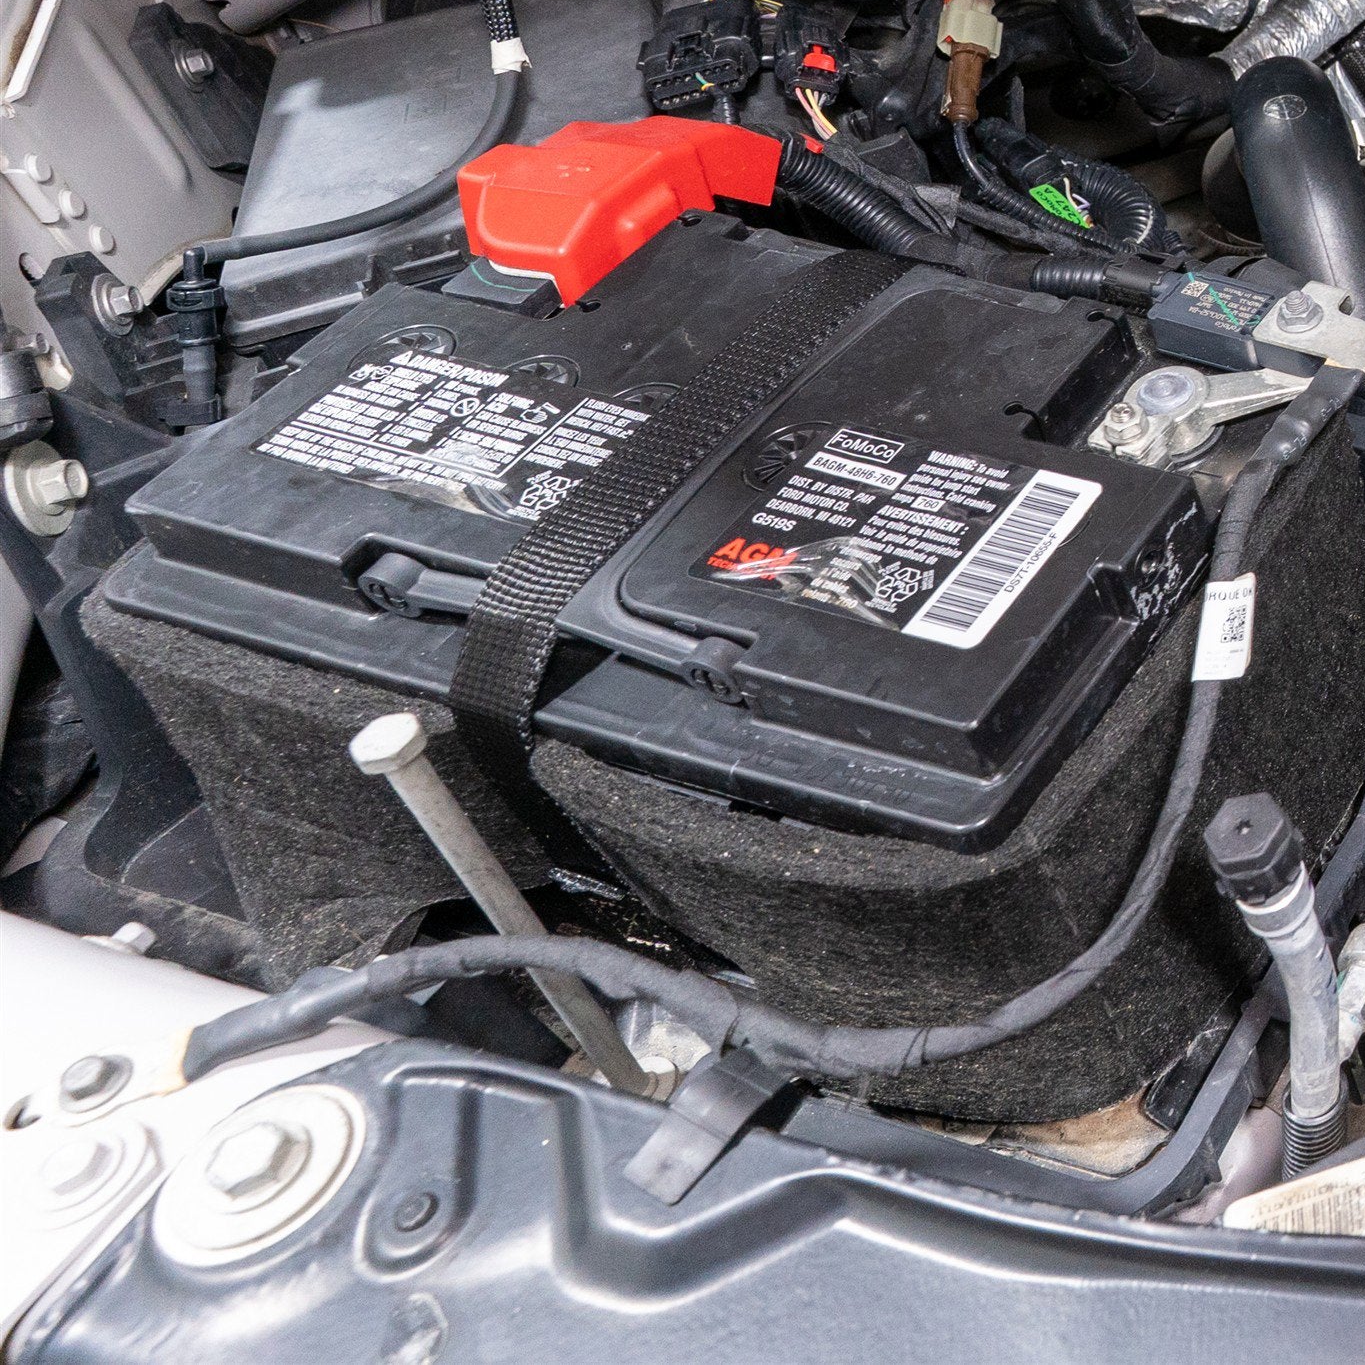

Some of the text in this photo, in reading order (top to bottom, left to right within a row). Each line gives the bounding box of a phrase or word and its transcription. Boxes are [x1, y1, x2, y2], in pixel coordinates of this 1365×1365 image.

[405, 352, 509, 389] DANGER/POISON
[830, 432, 898, 459] FoMoCo
[812, 456, 898, 486] BAGM-48H6-760
[915, 461, 1011, 491] personal injury see owner
[924, 449, 1010, 479] WARNING: To avoid
[775, 485, 853, 513] FORD MOTOR CO.
[787, 474, 878, 505] DIST. BY DISTR. PAR
[889, 491, 940, 510] amps 760
[943, 490, 967, 503] Cold
[959, 495, 999, 514] cranking
[959, 483, 983, 496] start
[749, 510, 799, 532] G519S
[764, 497, 857, 528] DEARBORN, MI 48121
[866, 514, 890, 527] Pour
[905, 525, 926, 537] des
[875, 502, 965, 535] AVERTISSEMENT
[857, 524, 880, 536] Voir
[712, 534, 800, 574] AGM
[1004, 532, 1056, 592] DS7T-10655-F
